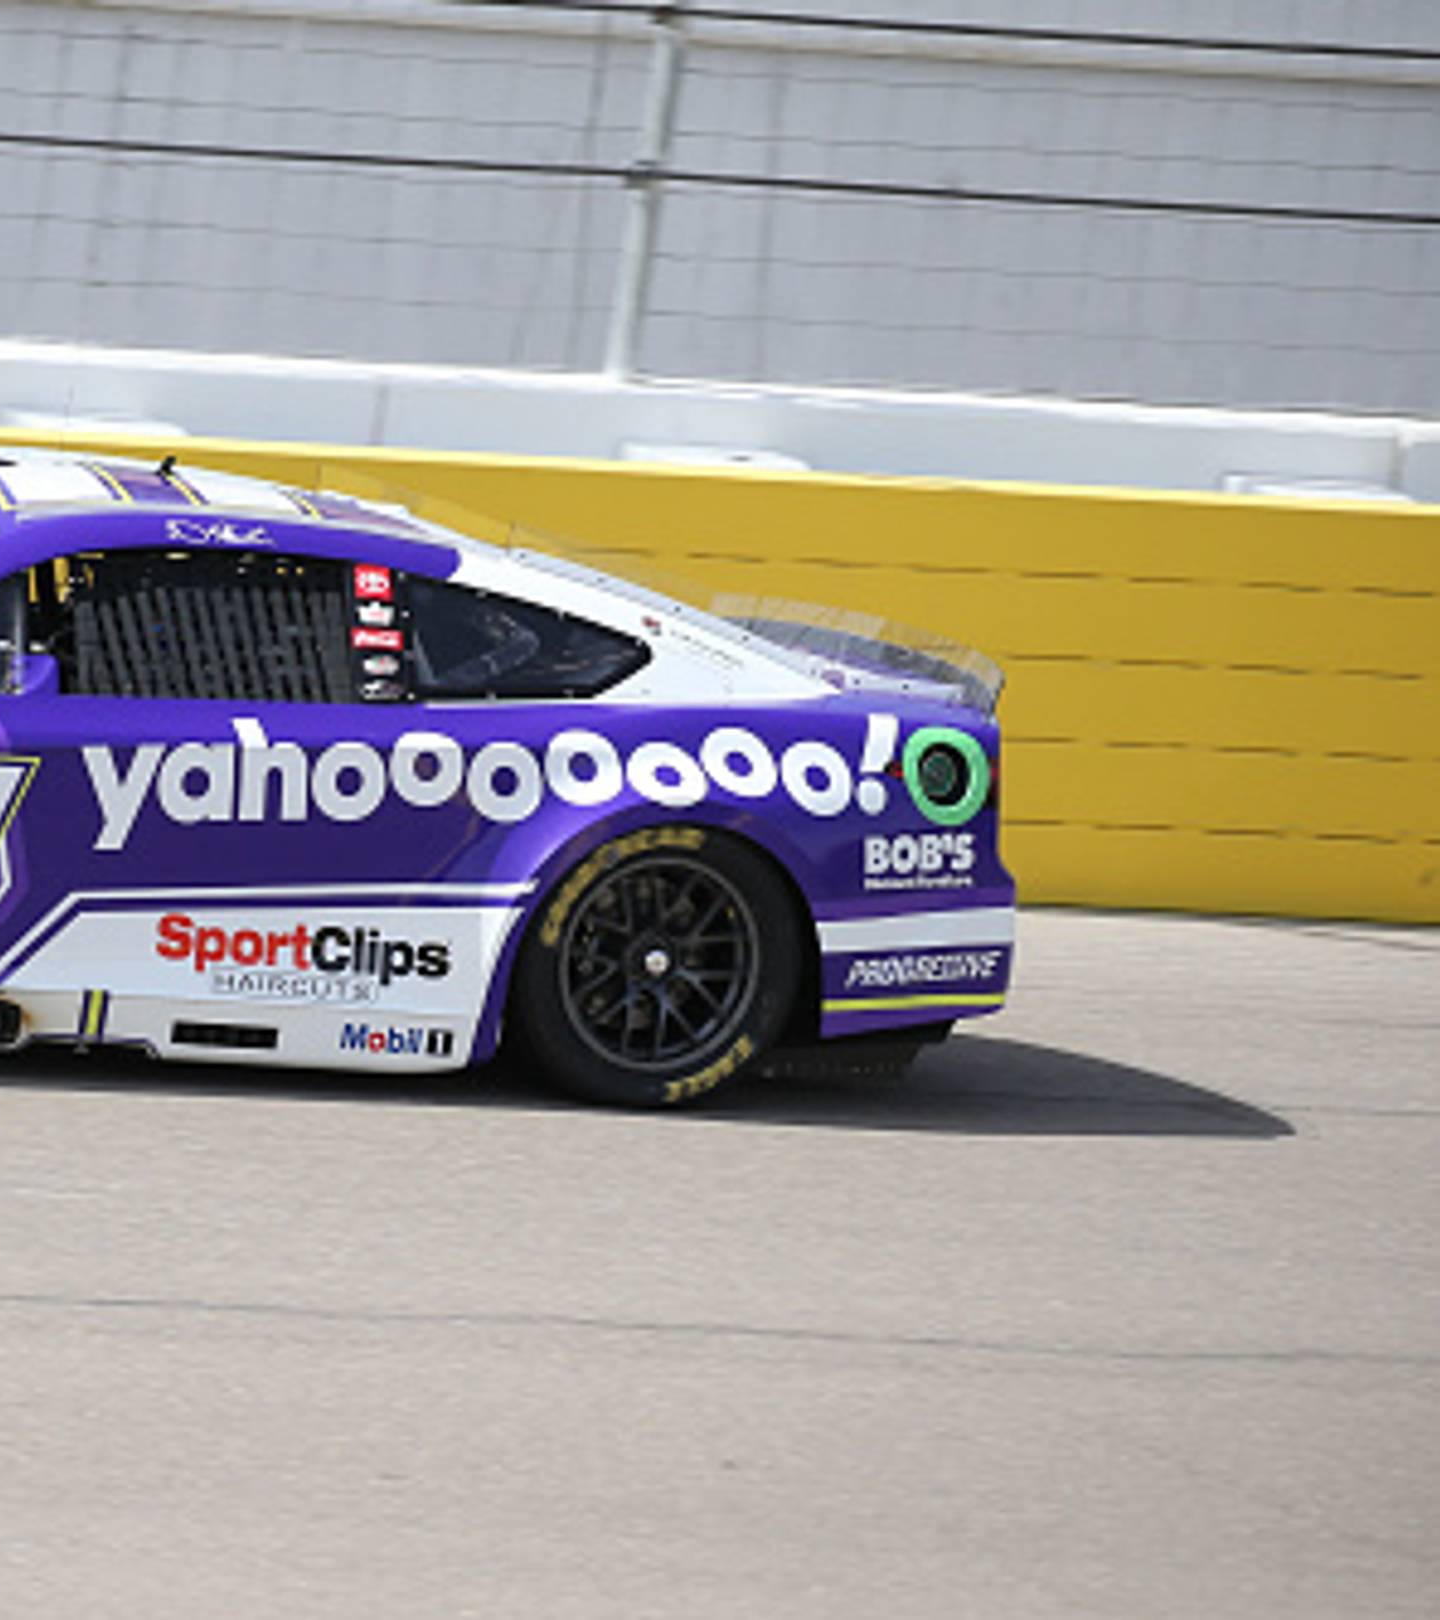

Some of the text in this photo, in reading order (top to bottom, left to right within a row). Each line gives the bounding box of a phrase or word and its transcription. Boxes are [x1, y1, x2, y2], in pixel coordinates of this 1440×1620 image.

[80, 713, 900, 851] yahooooooo!
[863, 832, 976, 875] BOB'S
[339, 1022, 424, 1056] Mobil
